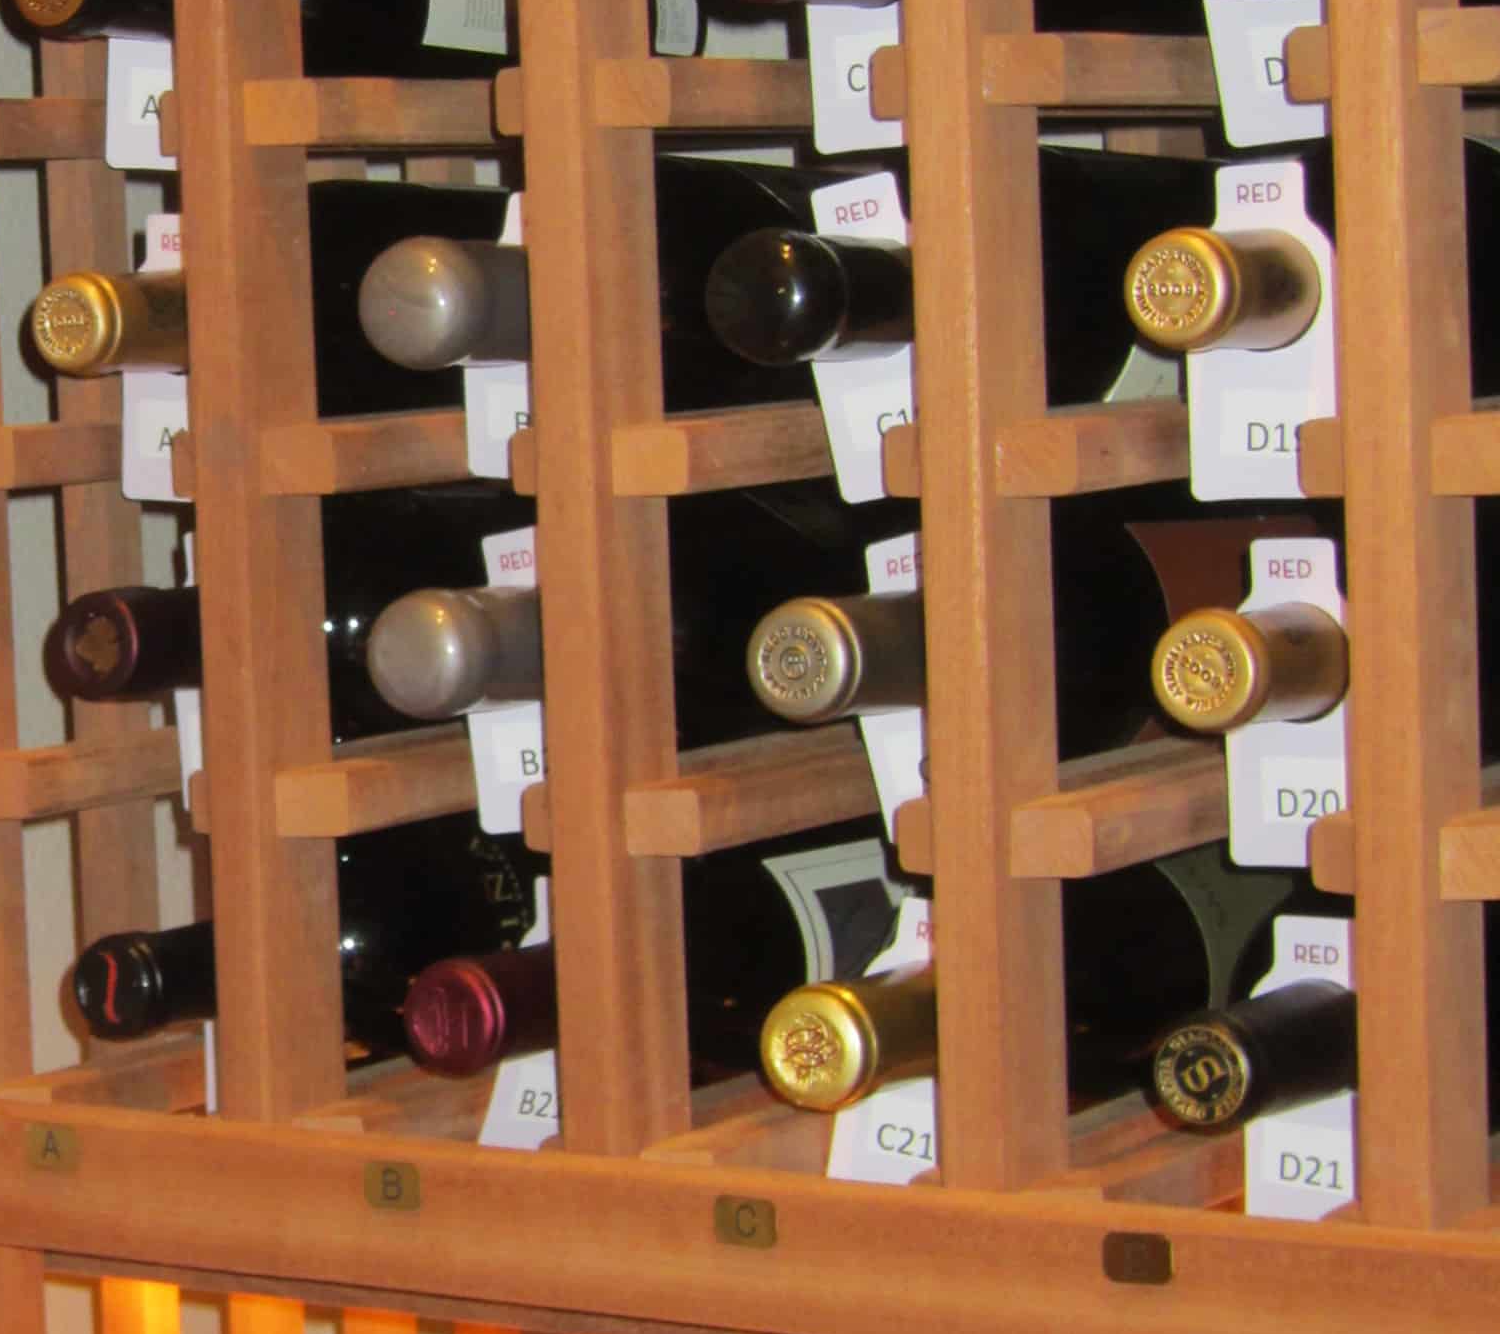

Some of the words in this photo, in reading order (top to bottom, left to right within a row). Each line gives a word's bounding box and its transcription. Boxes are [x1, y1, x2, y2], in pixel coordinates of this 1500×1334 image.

[1236, 182, 1282, 205] RED
[835, 198, 878, 225] RED
[161, 233, 181, 252] RE
[499, 549, 534, 572] RED
[1268, 558, 1312, 580] RED
[1276, 788, 1341, 819] D20
[1294, 943, 1340, 966] RED
[517, 1088, 558, 1120] B2
[41, 1130, 62, 1161] A
[876, 1122, 934, 1161] C21
[381, 1167, 403, 1201] B
[1279, 1152, 1343, 1190] D21
[735, 1203, 757, 1229] C
